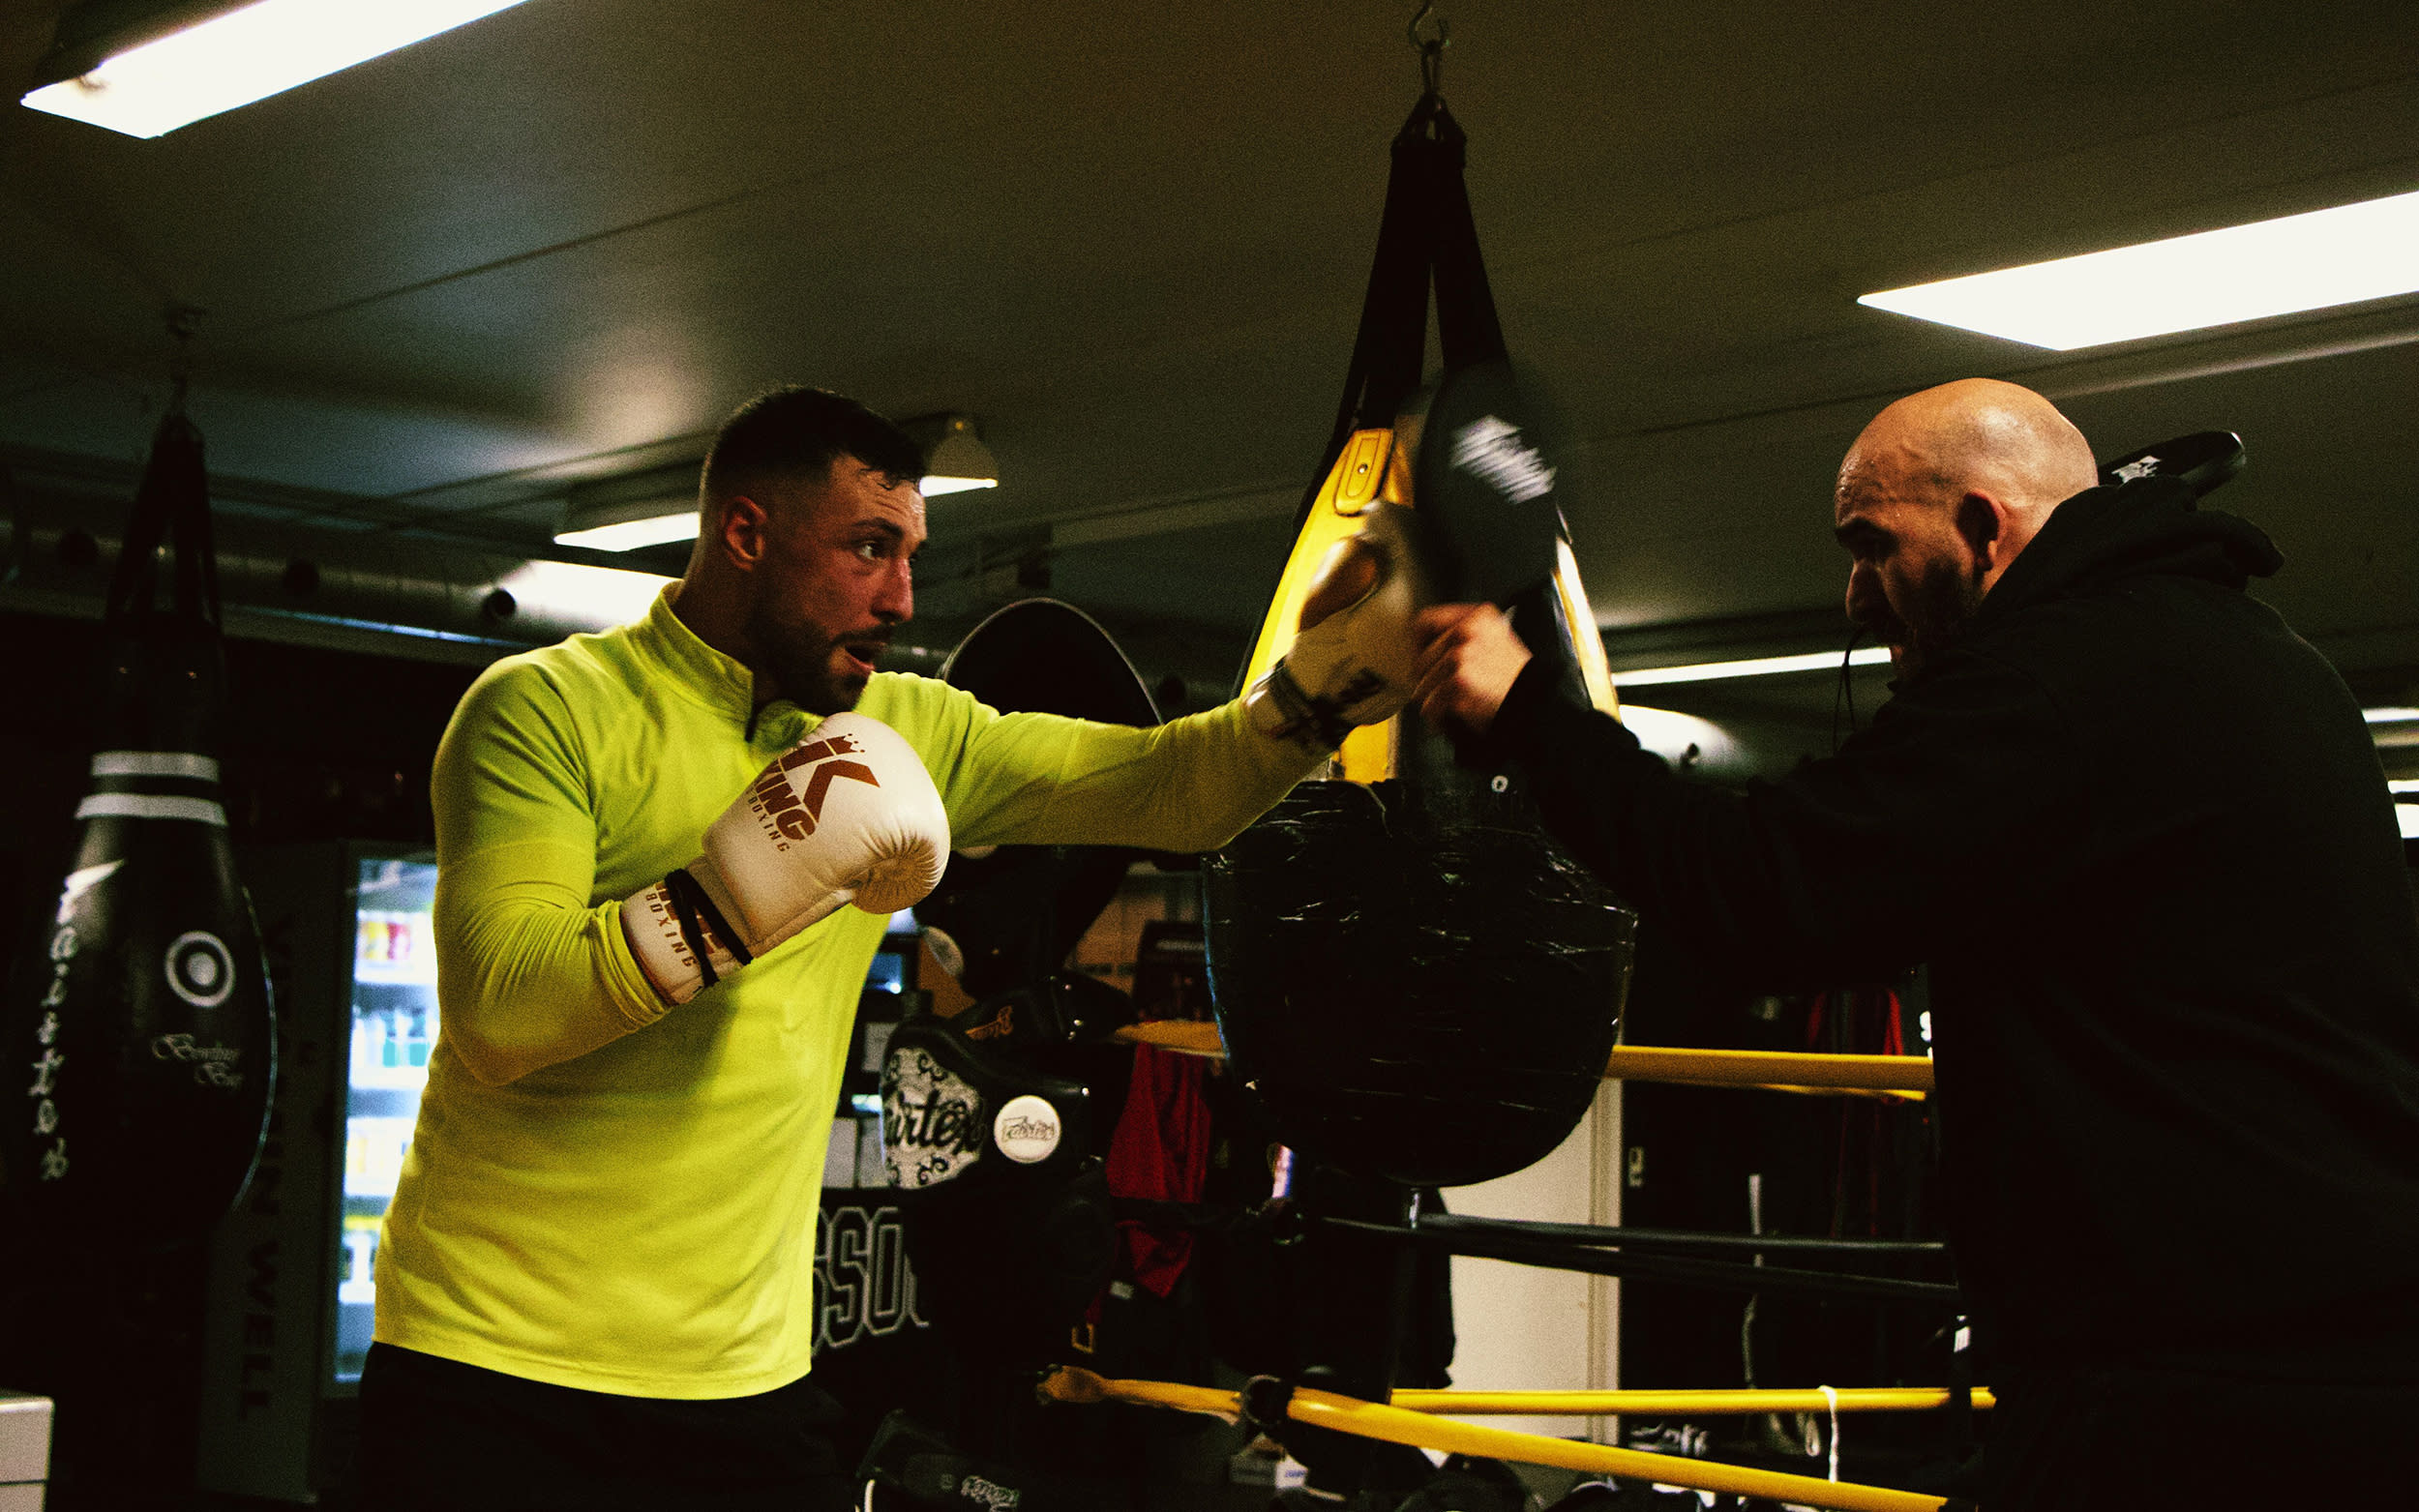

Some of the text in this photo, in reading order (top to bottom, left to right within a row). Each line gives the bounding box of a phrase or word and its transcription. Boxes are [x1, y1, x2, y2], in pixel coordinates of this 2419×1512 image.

[747, 795, 791, 853] BOXING
[645, 893, 698, 967] BOXING
[239, 1240, 283, 1420] WELL
